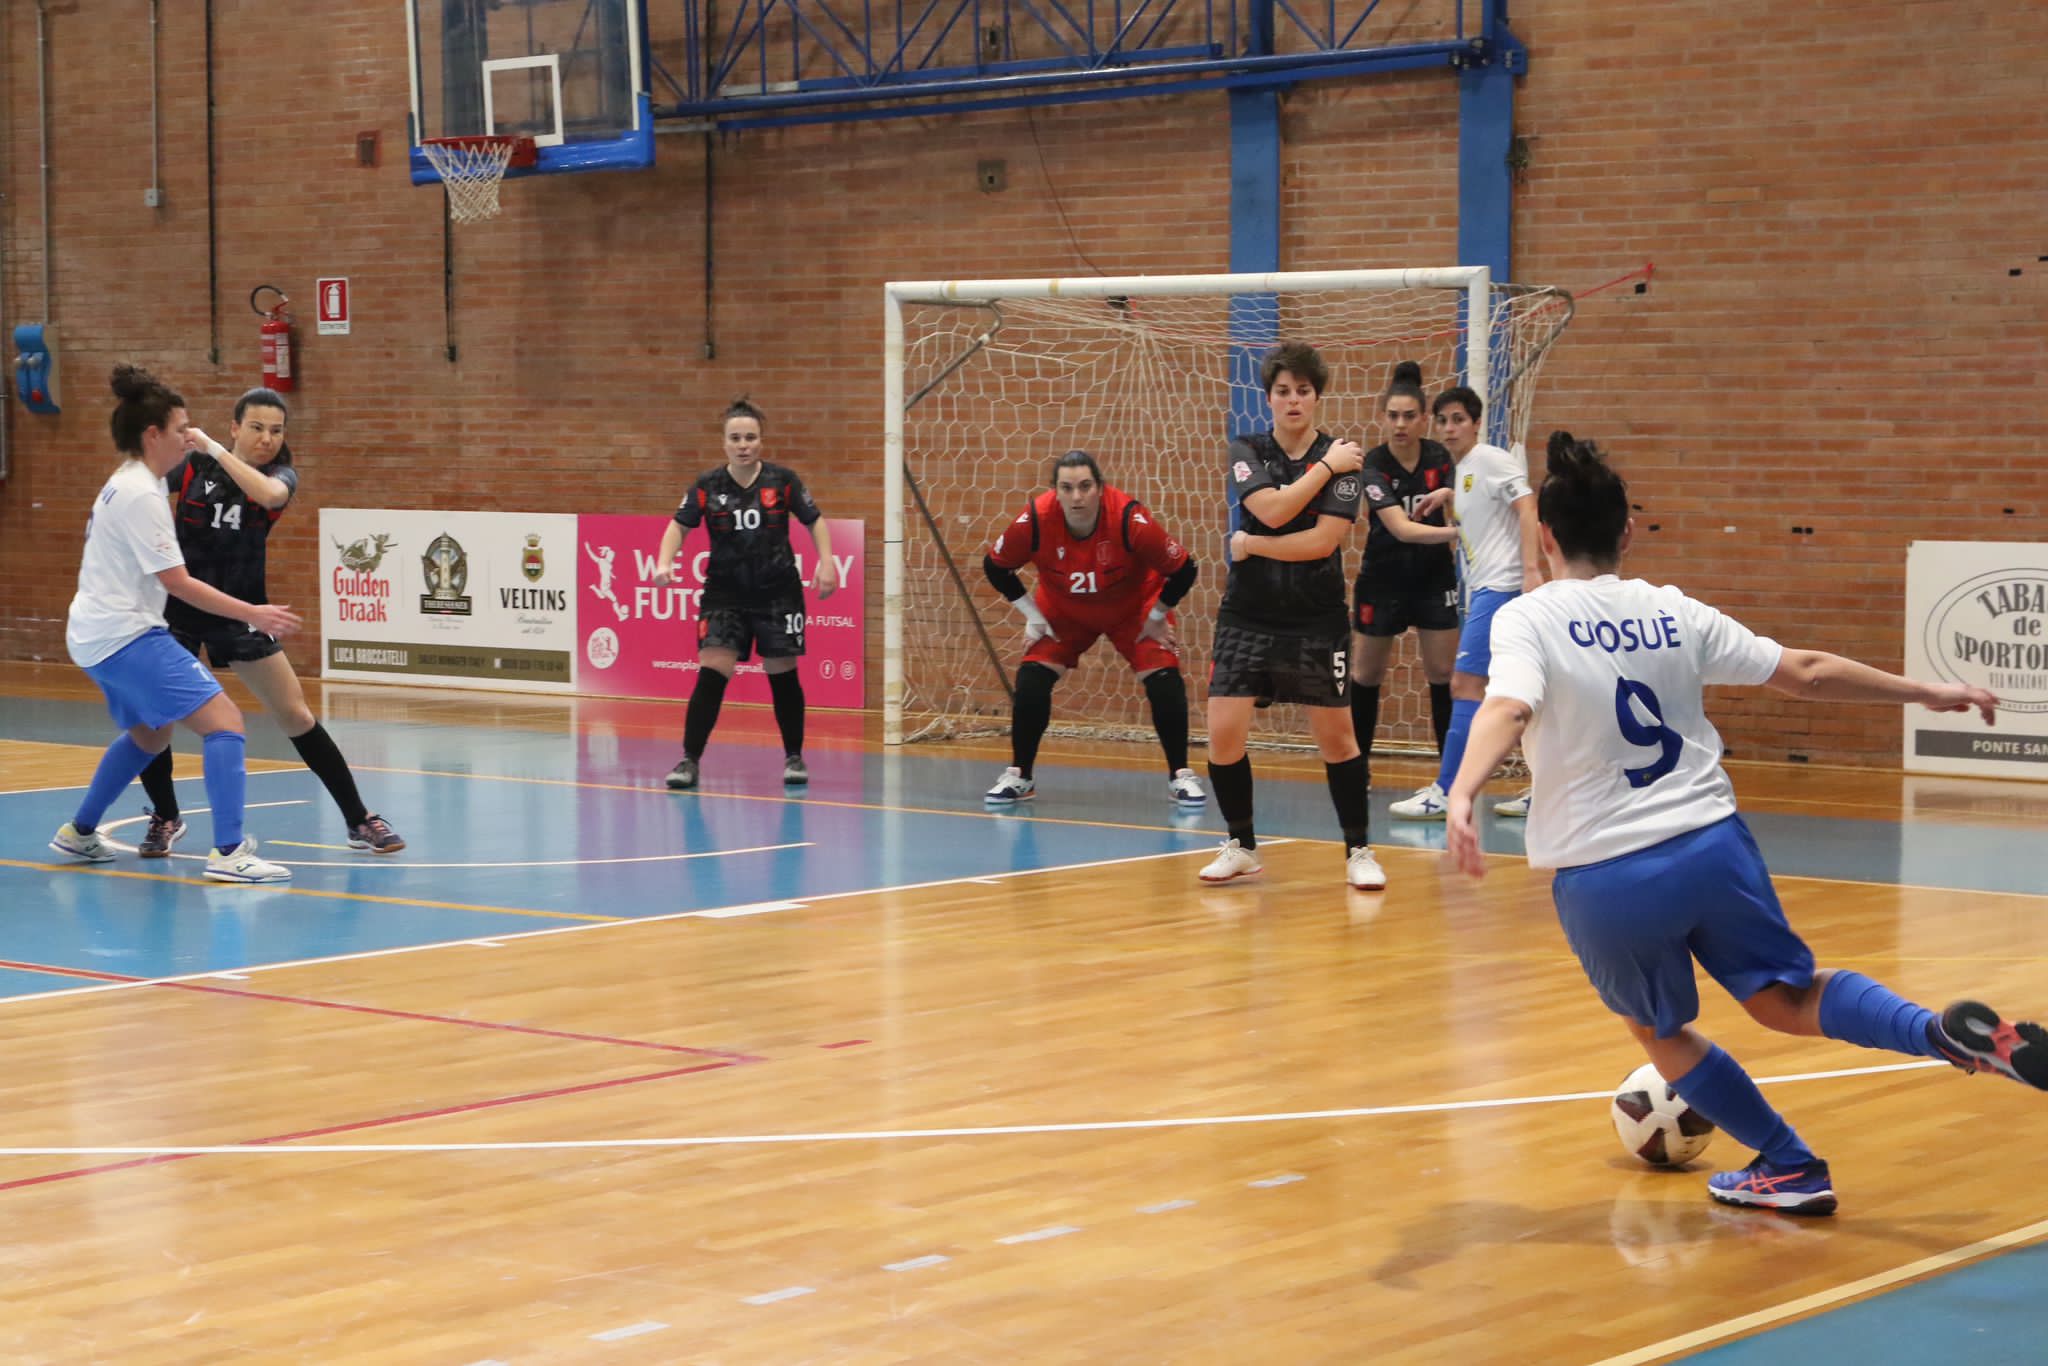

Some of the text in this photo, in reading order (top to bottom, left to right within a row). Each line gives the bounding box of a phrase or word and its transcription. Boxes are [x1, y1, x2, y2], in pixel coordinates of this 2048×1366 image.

[211, 503, 242, 530] 14
[733, 508, 761, 531] 10
[333, 566, 390, 598] Gulden
[1069, 571, 1098, 594] 21
[339, 598, 388, 622] Draak
[499, 587, 567, 612] VELTINS
[1976, 583, 2048, 619] TABA
[785, 612, 804, 634] 10
[816, 615, 857, 628] FUTSAL
[2013, 616, 2042, 637] de
[1333, 651, 1346, 679] 5
[1615, 676, 1684, 788] 9
[1972, 740, 2021, 755] PONTE
